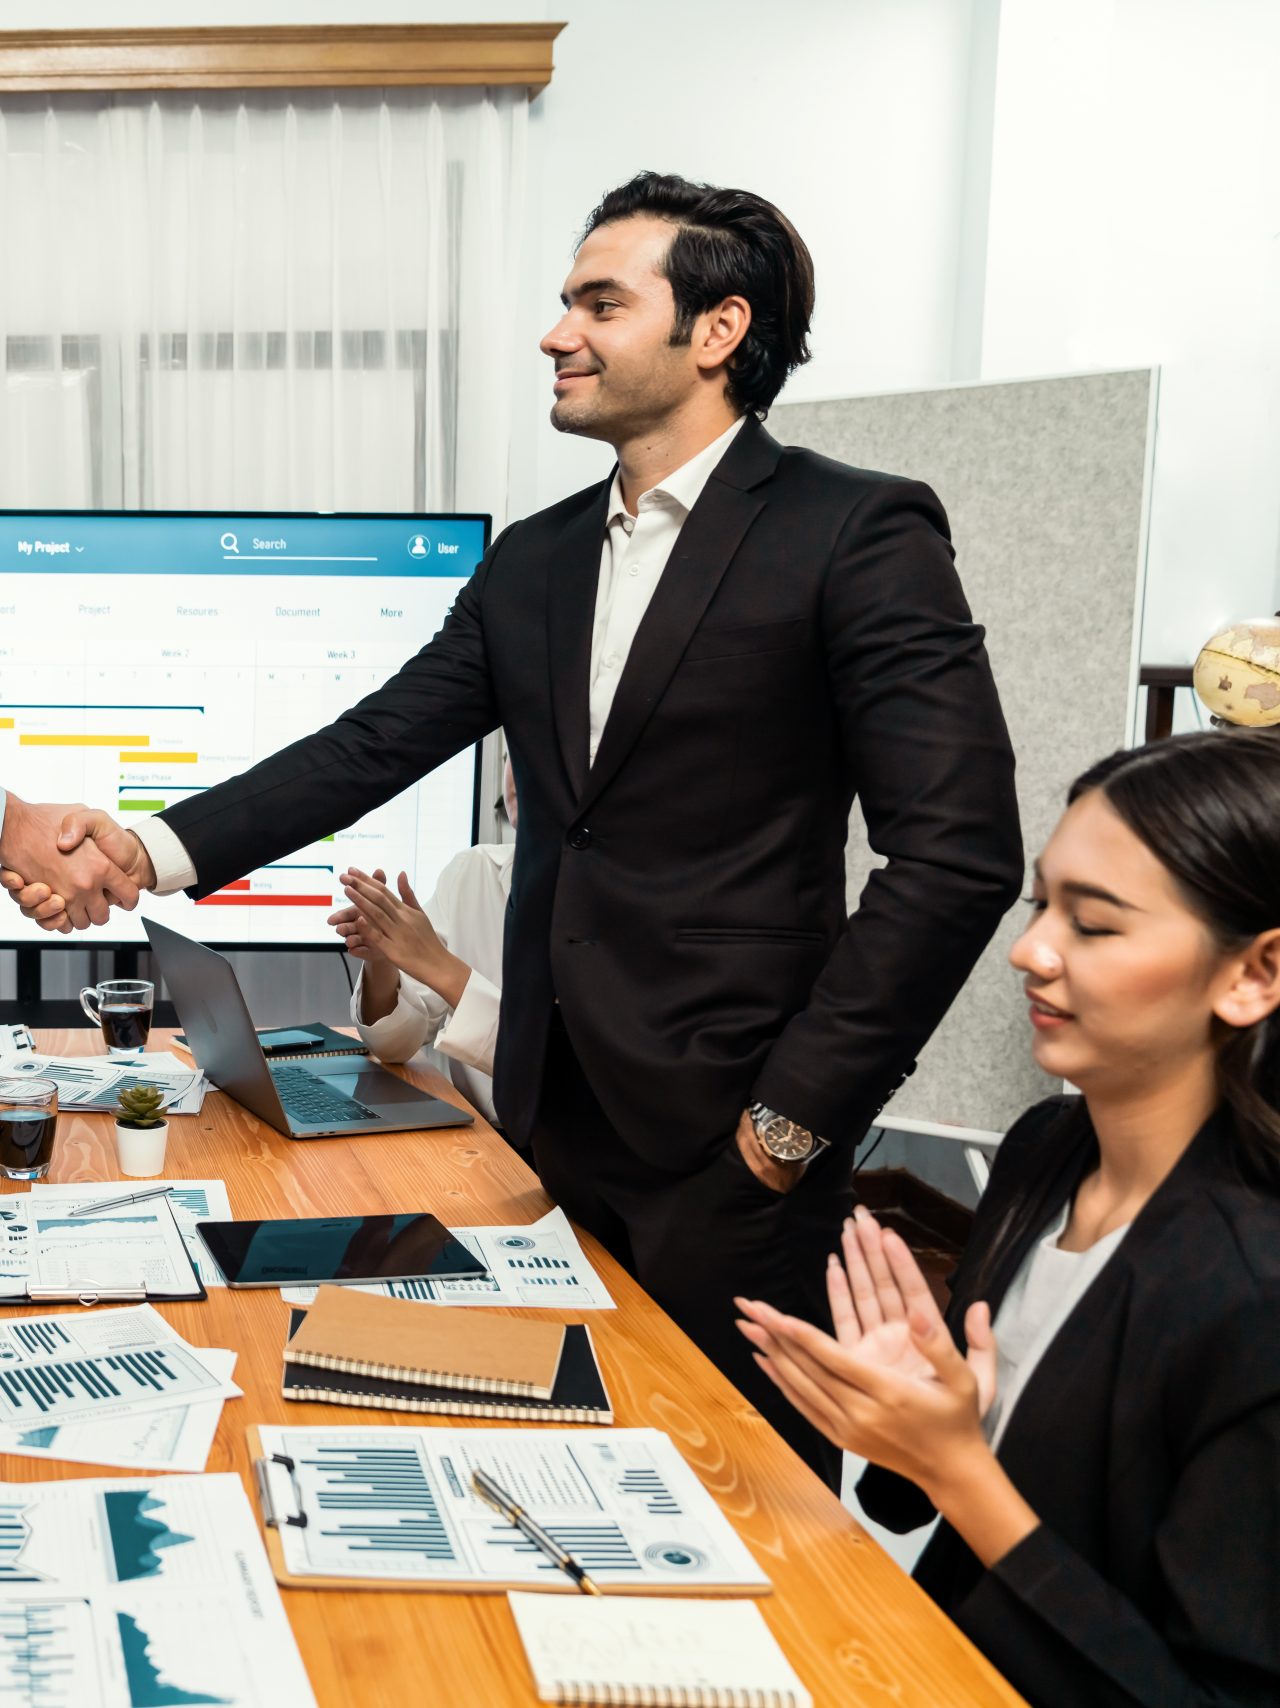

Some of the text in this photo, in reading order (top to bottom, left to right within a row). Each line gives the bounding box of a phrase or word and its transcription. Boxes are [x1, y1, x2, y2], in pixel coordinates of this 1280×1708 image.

[17, 541, 71, 556] My Project
[252, 537, 287, 550] Search
[437, 542, 460, 555] User
[77, 603, 111, 617] Project
[176, 605, 219, 617] Resoures
[275, 606, 321, 617] Document
[380, 607, 403, 618] More
[327, 650, 348, 660] Week
